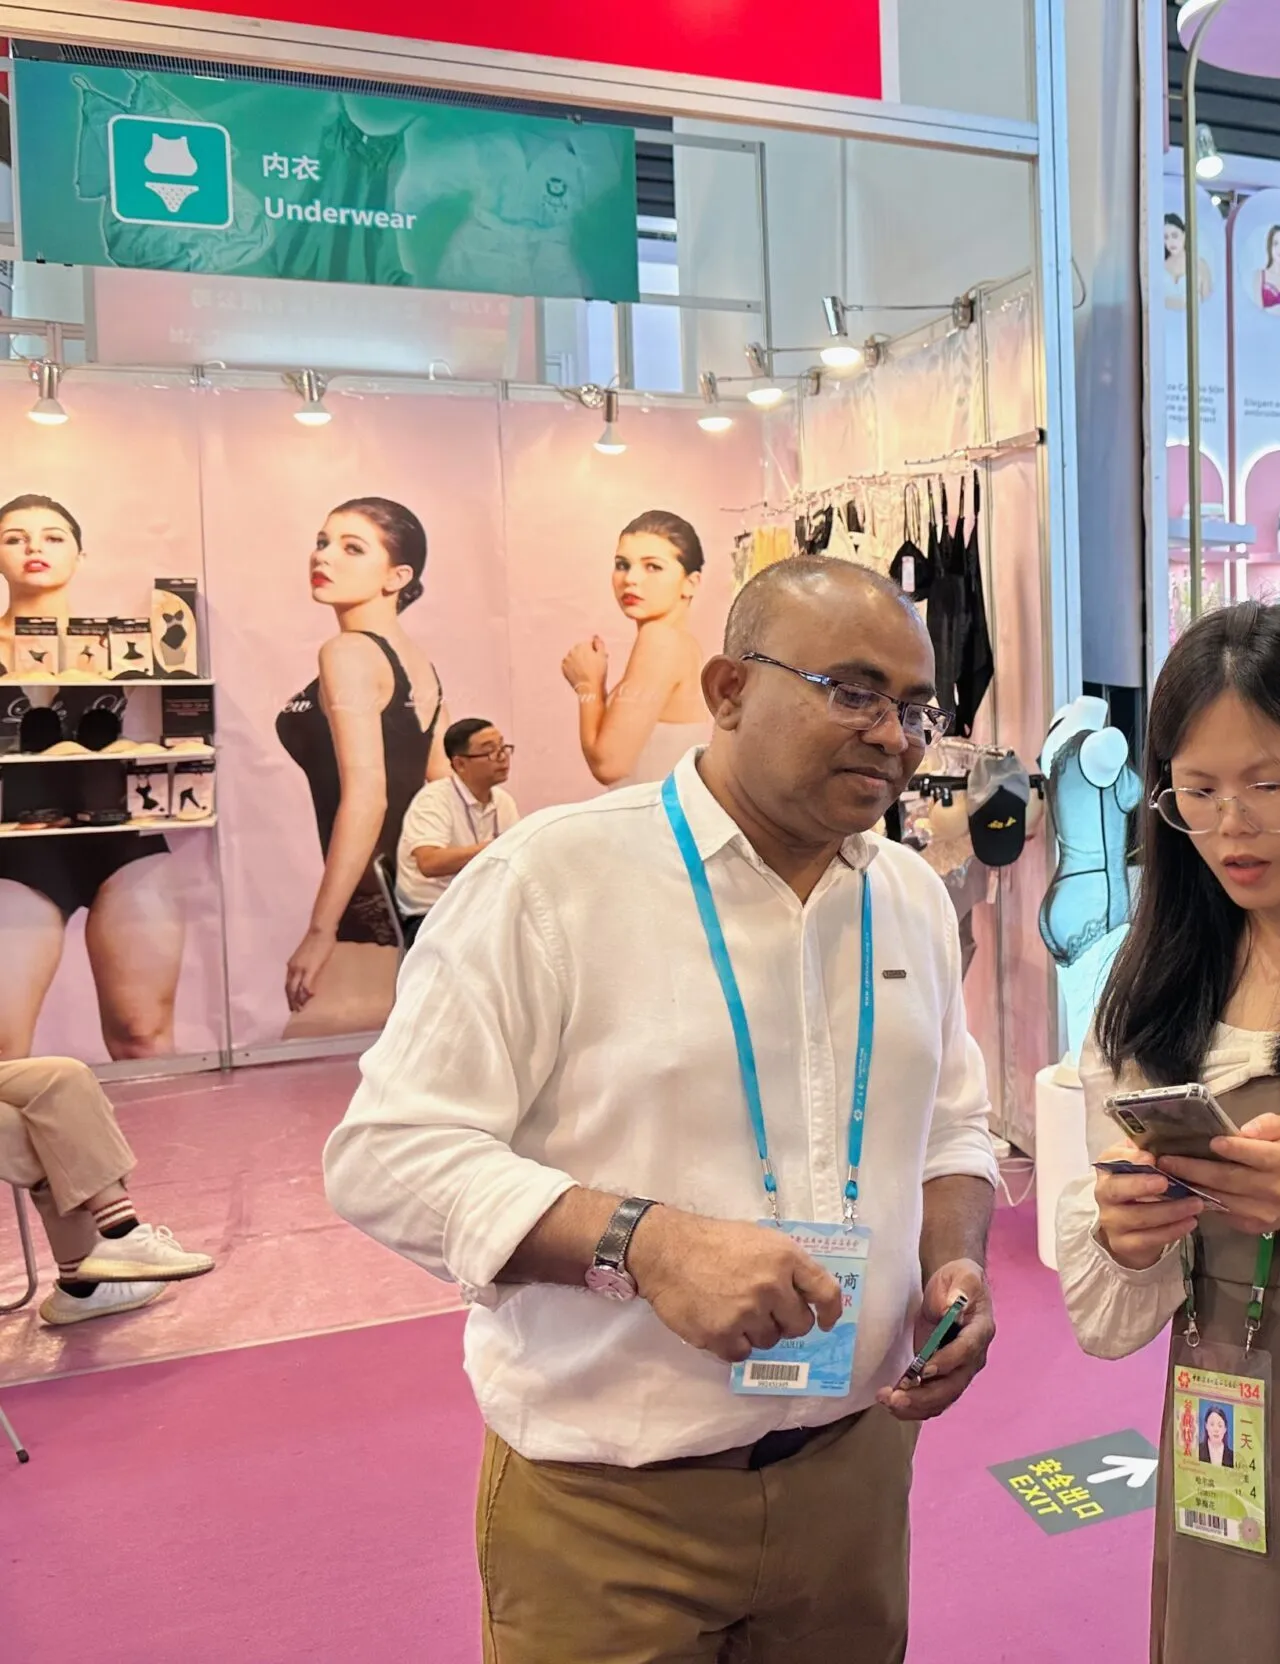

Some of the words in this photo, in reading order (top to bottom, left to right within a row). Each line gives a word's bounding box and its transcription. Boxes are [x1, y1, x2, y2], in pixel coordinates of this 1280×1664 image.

[262, 153, 320, 181] 内衣
[264, 197, 417, 230] Underwear
[1239, 1382, 1260, 1400] 134
[1249, 1458, 1257, 1472] 4
[1008, 1474, 1064, 1516] EXIT
[1028, 1458, 1104, 1519] 安全出口
[1249, 1486, 1257, 1499] 4
